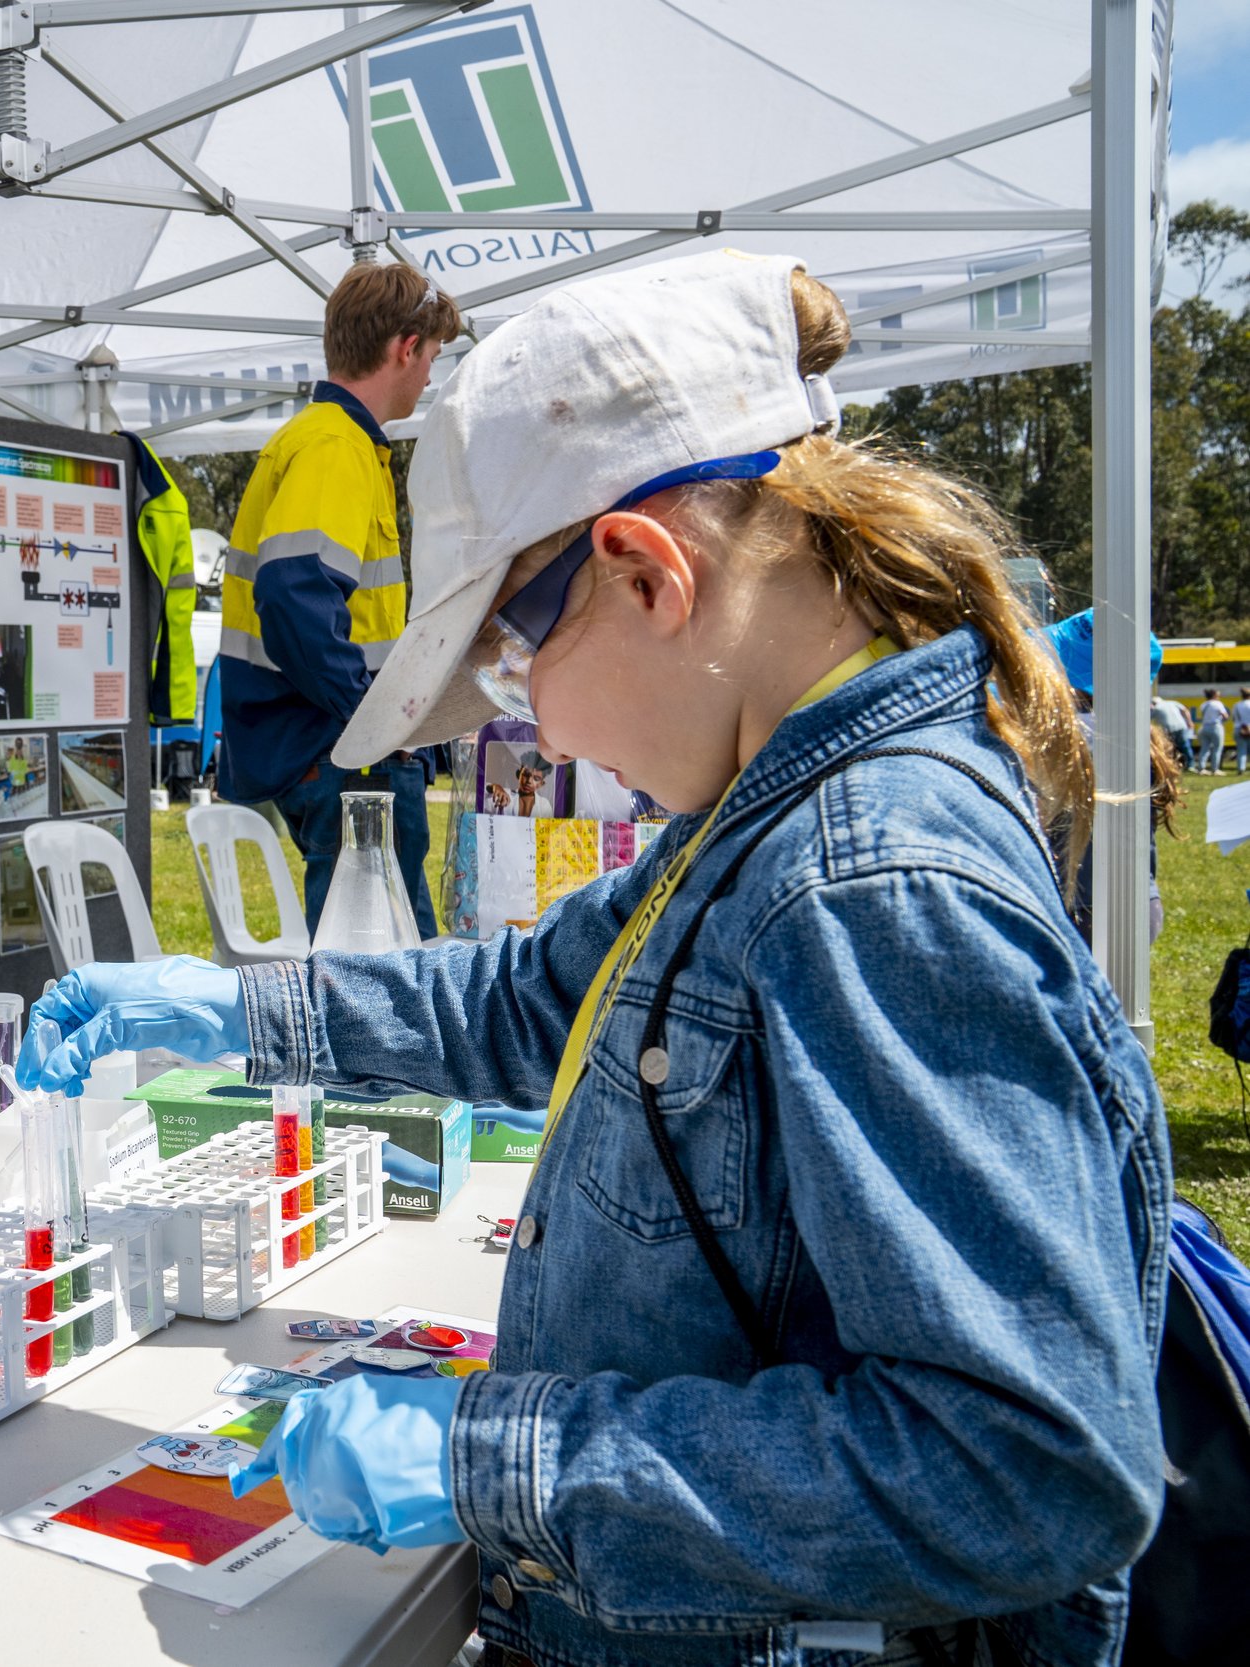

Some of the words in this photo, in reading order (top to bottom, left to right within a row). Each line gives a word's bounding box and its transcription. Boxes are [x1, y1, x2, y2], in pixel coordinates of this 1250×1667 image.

[162, 1114, 197, 1126] 92-670
[162, 1128, 187, 1136] Textured
[162, 1142, 186, 1150] Prevents
[109, 1149, 128, 1169] Sodium
[127, 1133, 157, 1157] Bicarbonate
[389, 1193, 429, 1208] Ansell
[318, 1355, 335, 1363] 11
[222, 1408, 234, 1416] 7
[107, 1469, 121, 1477] 3
[77, 1483, 92, 1492] 2
[44, 1500, 58, 1508] 1
[221, 1555, 252, 1575] VERY
[251, 1536, 287, 1559] ACIDIC
